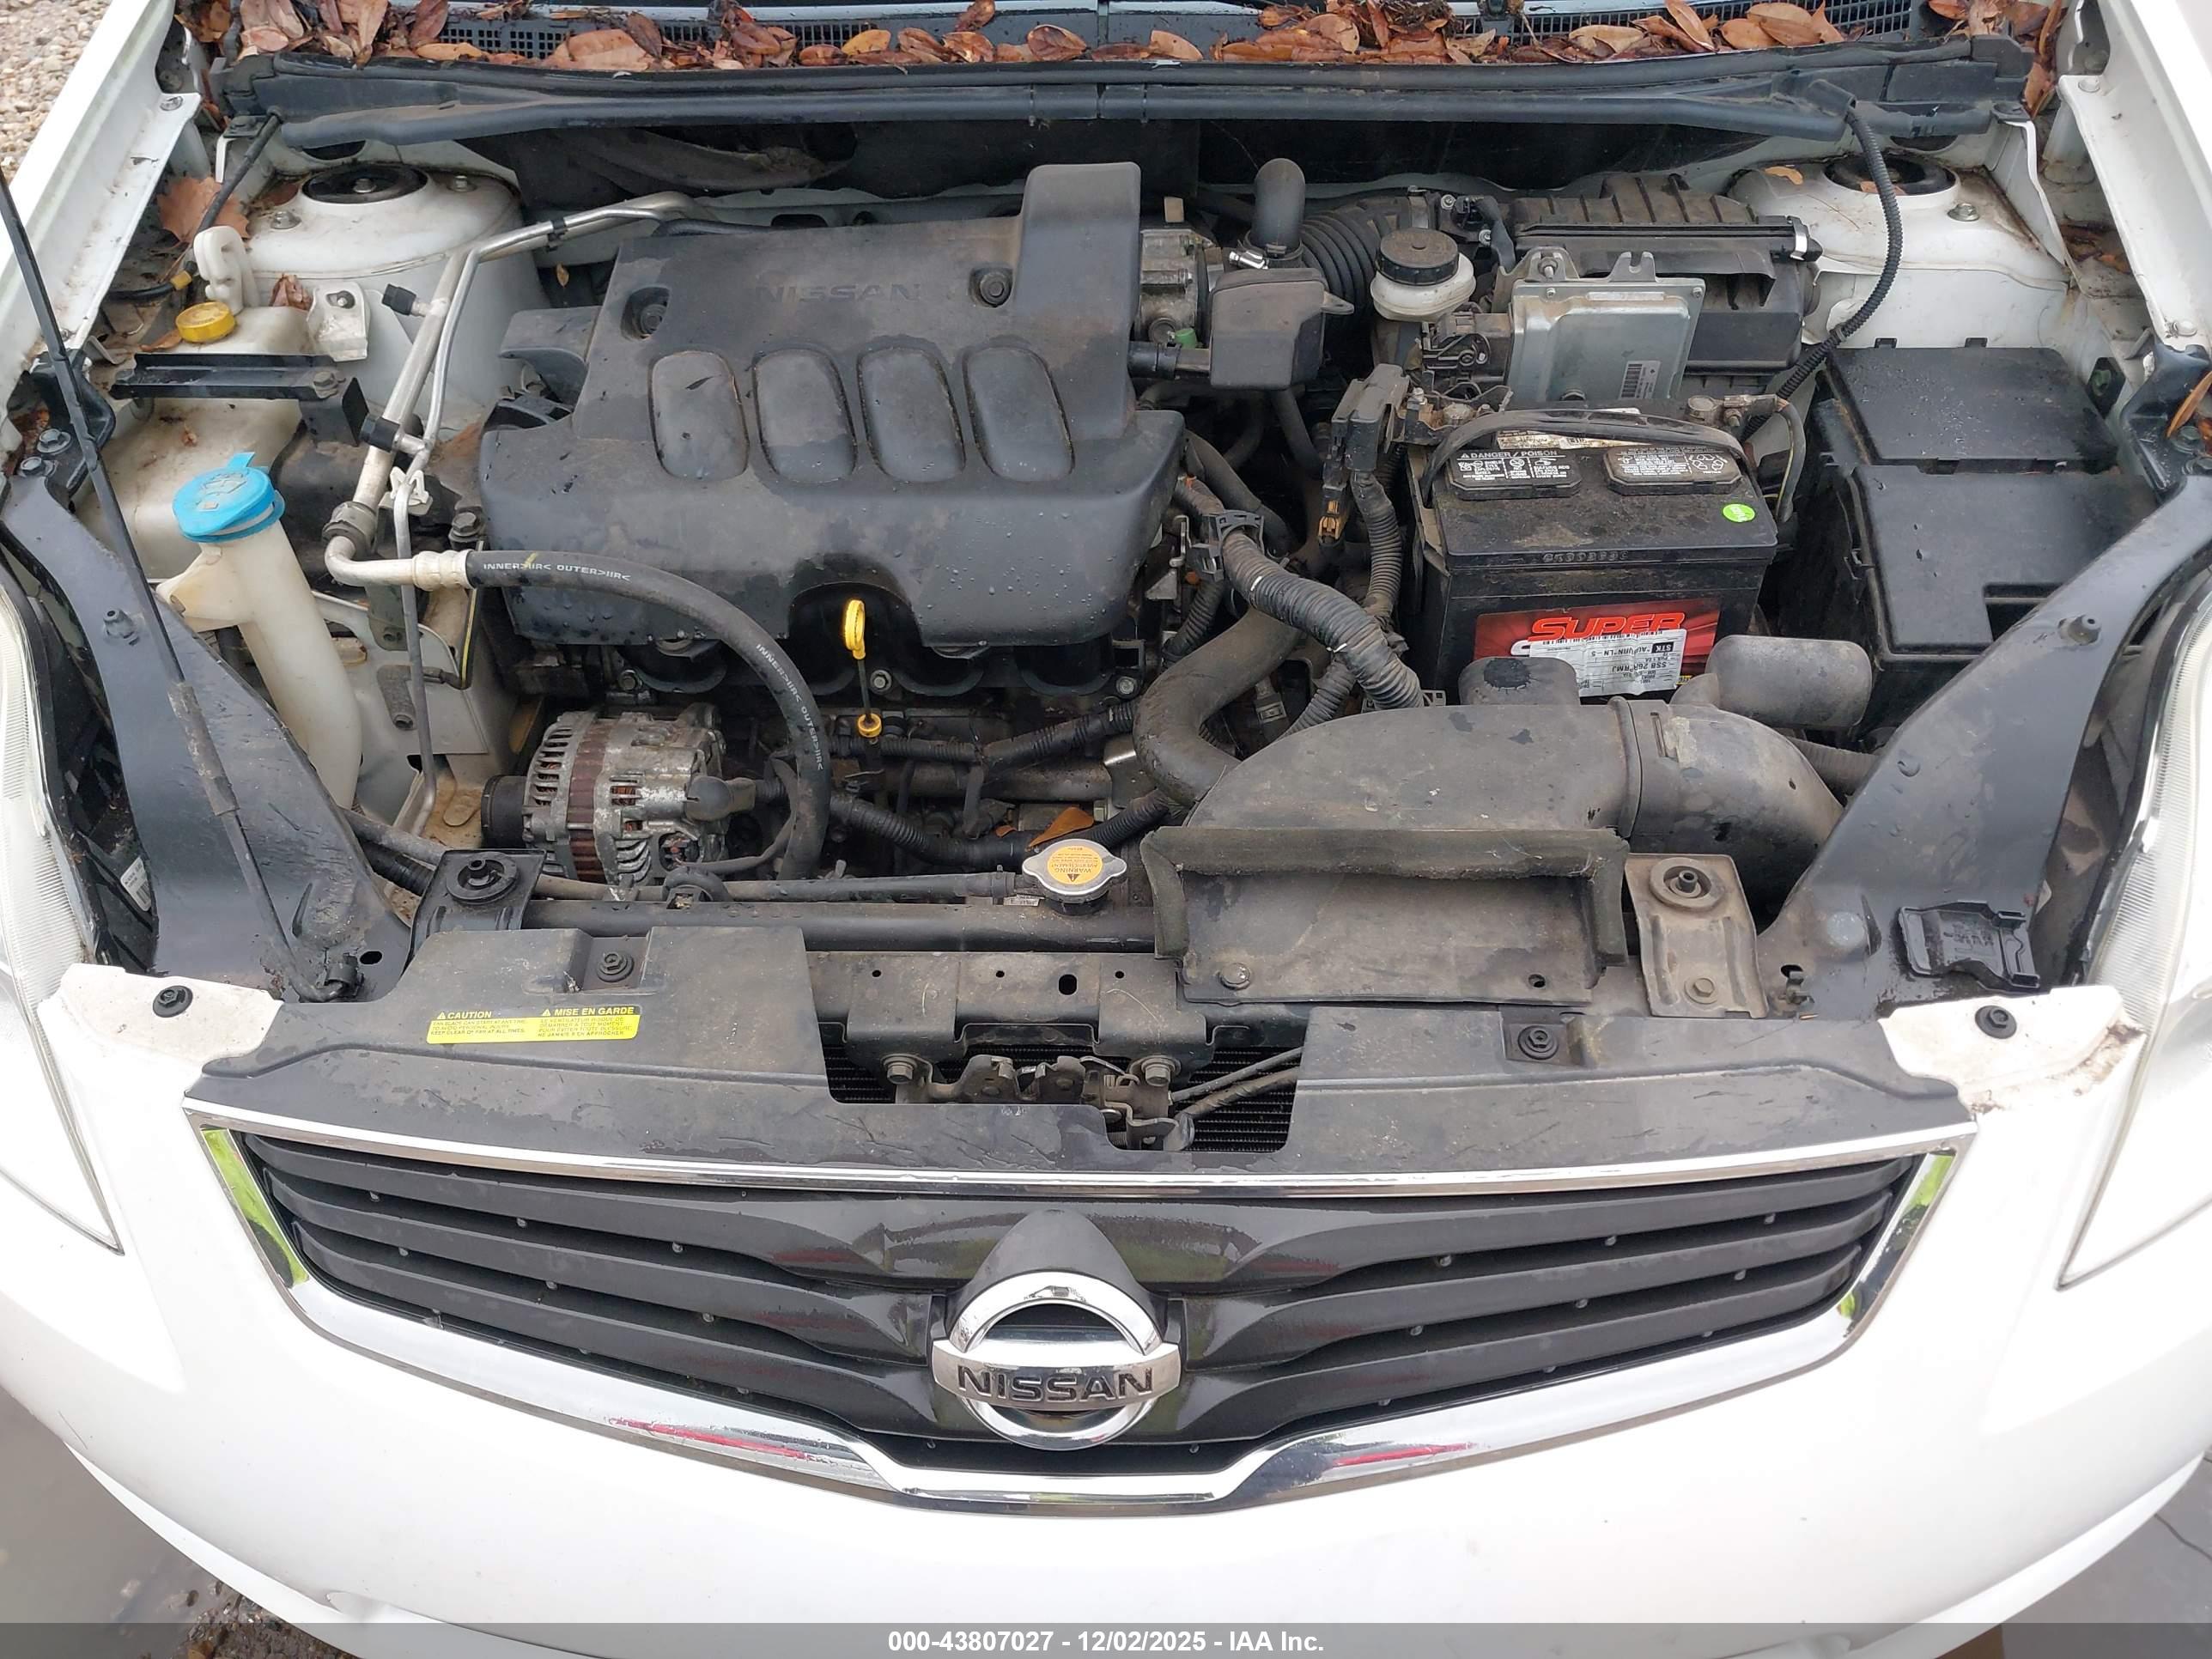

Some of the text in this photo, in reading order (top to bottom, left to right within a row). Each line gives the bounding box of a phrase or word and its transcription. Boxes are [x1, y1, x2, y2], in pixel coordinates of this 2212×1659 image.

[755, 283, 921, 301] NISSAN
[1528, 612, 1686, 642] SUPER
[1656, 644, 1672, 653] STK
[447, 1011, 492, 1019] CAUTION
[598, 1006, 635, 1015] GARDE
[957, 1364, 1152, 1403] NISSAN
